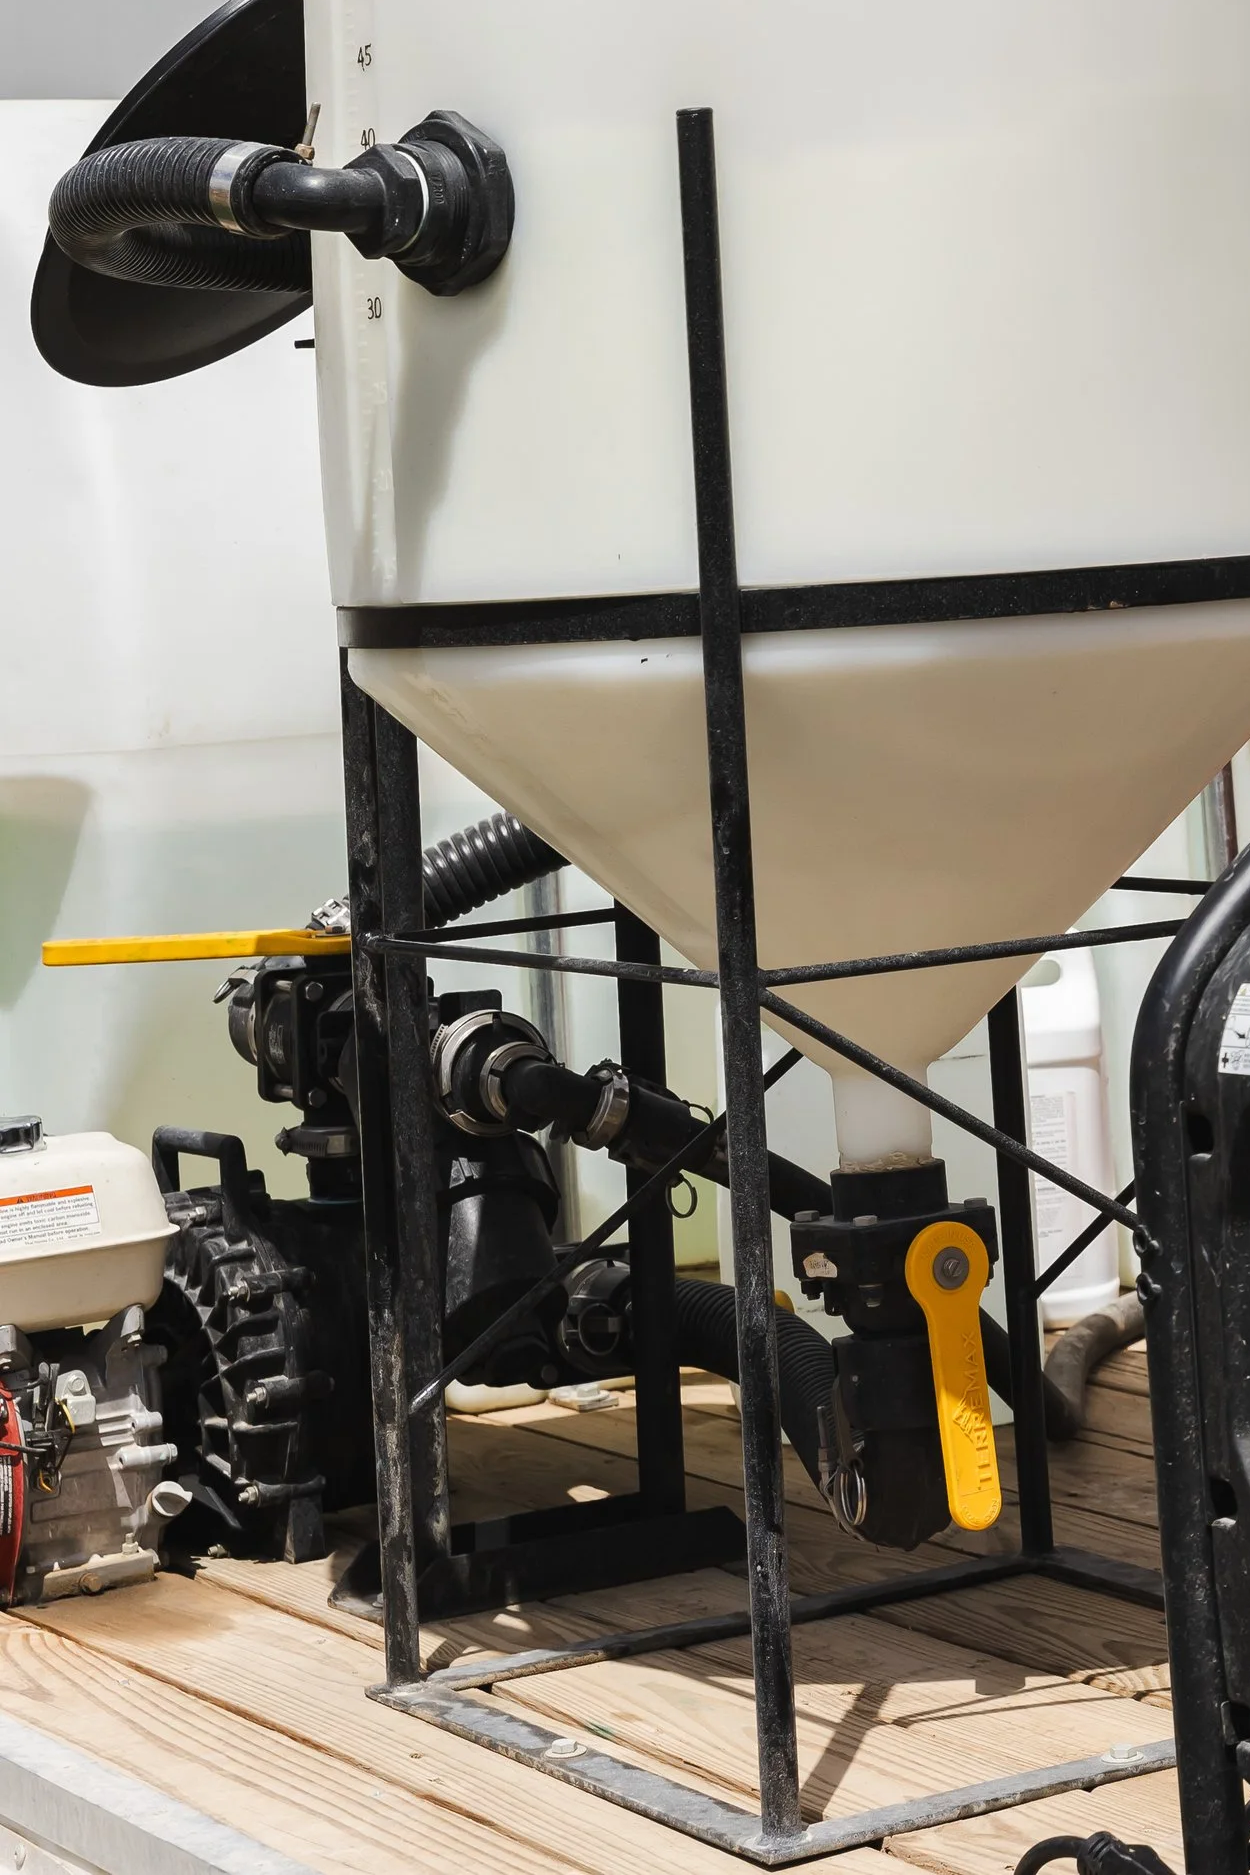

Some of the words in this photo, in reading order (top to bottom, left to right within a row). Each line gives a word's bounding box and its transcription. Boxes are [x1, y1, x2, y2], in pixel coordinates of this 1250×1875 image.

[357, 43, 372, 72] 45
[361, 128, 376, 151] 40
[367, 296, 382, 320] 30
